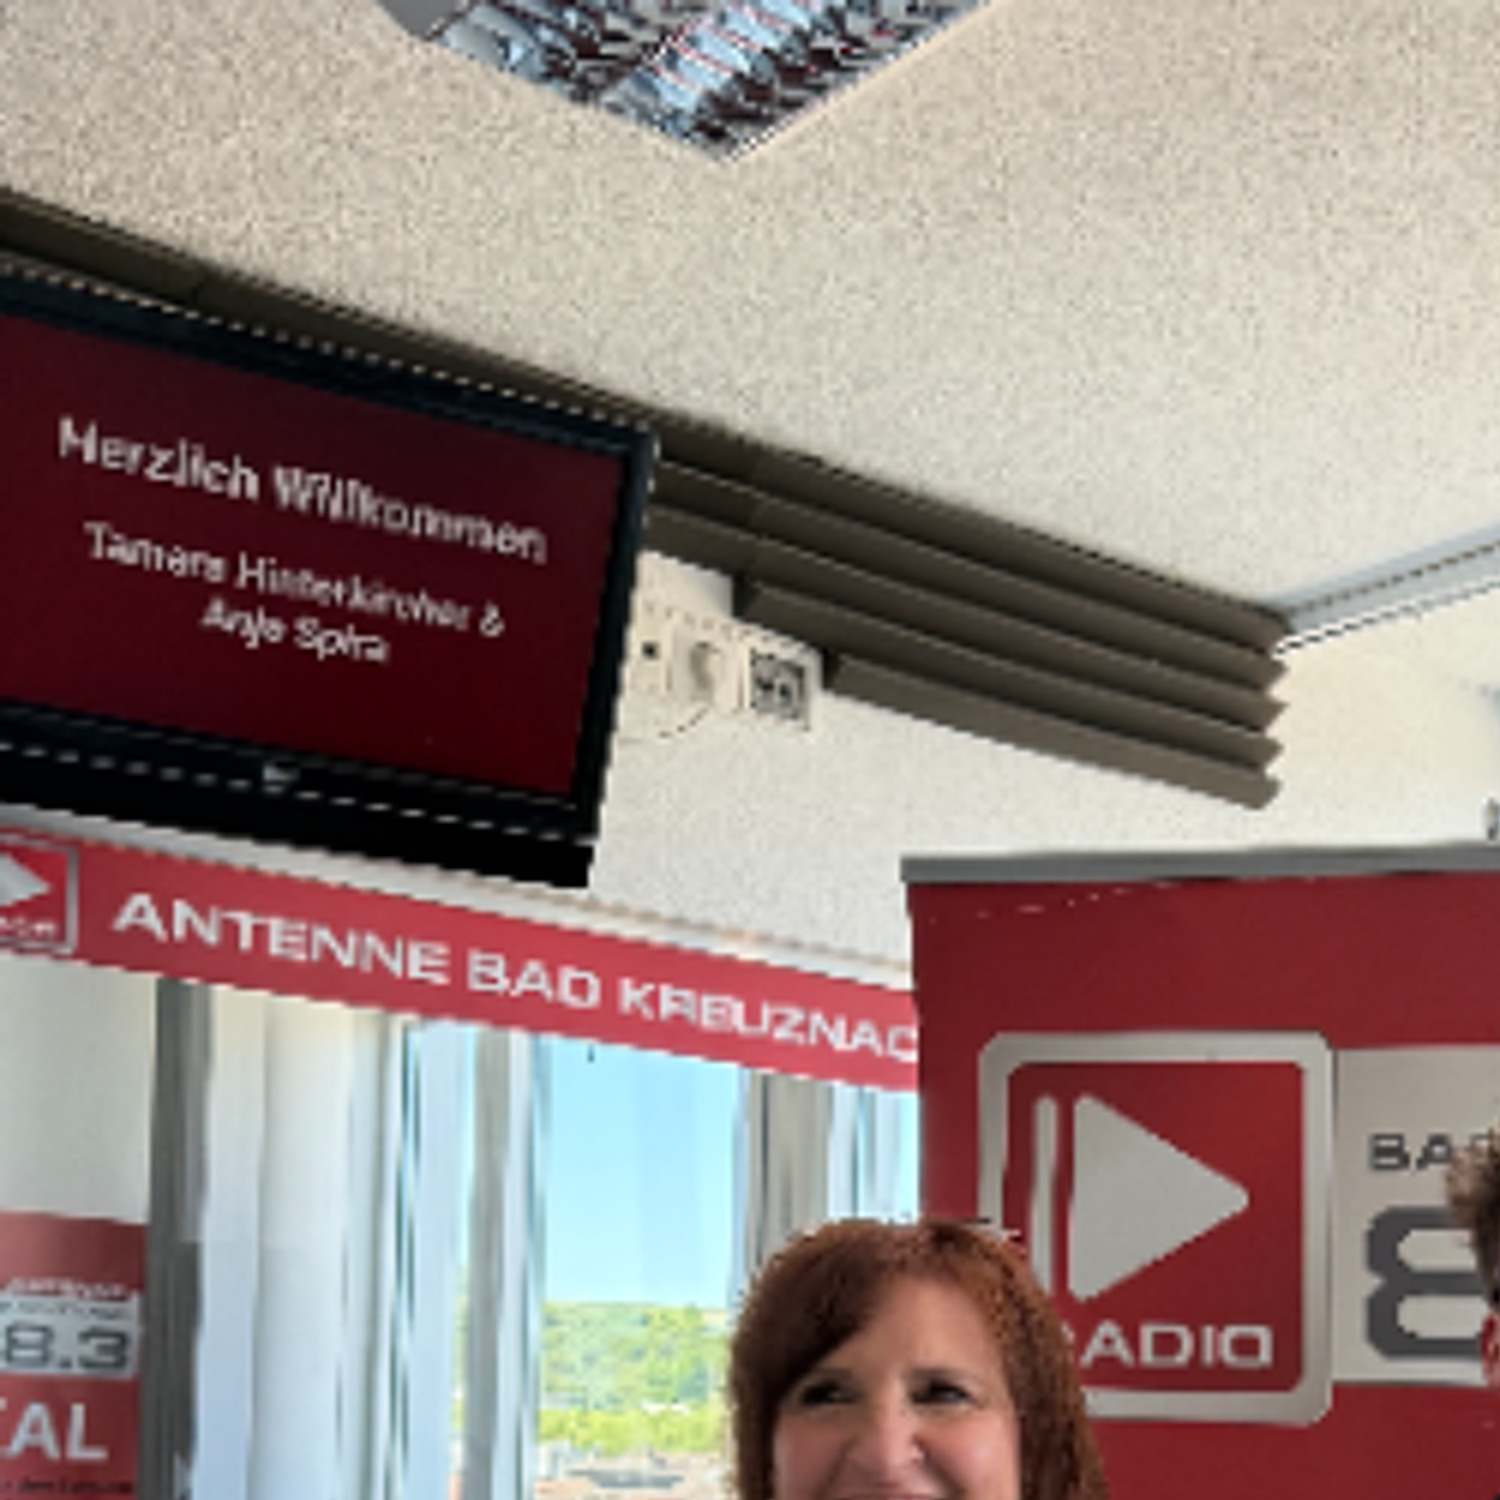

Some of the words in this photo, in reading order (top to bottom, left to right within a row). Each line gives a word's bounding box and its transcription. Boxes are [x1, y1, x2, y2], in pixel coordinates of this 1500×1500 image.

[59, 416, 259, 501] Herzlich
[273, 465, 547, 565] Willkommen
[83, 520, 225, 583] Tamara
[479, 602, 505, 638] &
[112, 892, 452, 985] ANTENNE
[467, 948, 603, 1010] BAD
[1368, 1133, 1492, 1172] BA
[1060, 1317, 1276, 1370] ADIO
